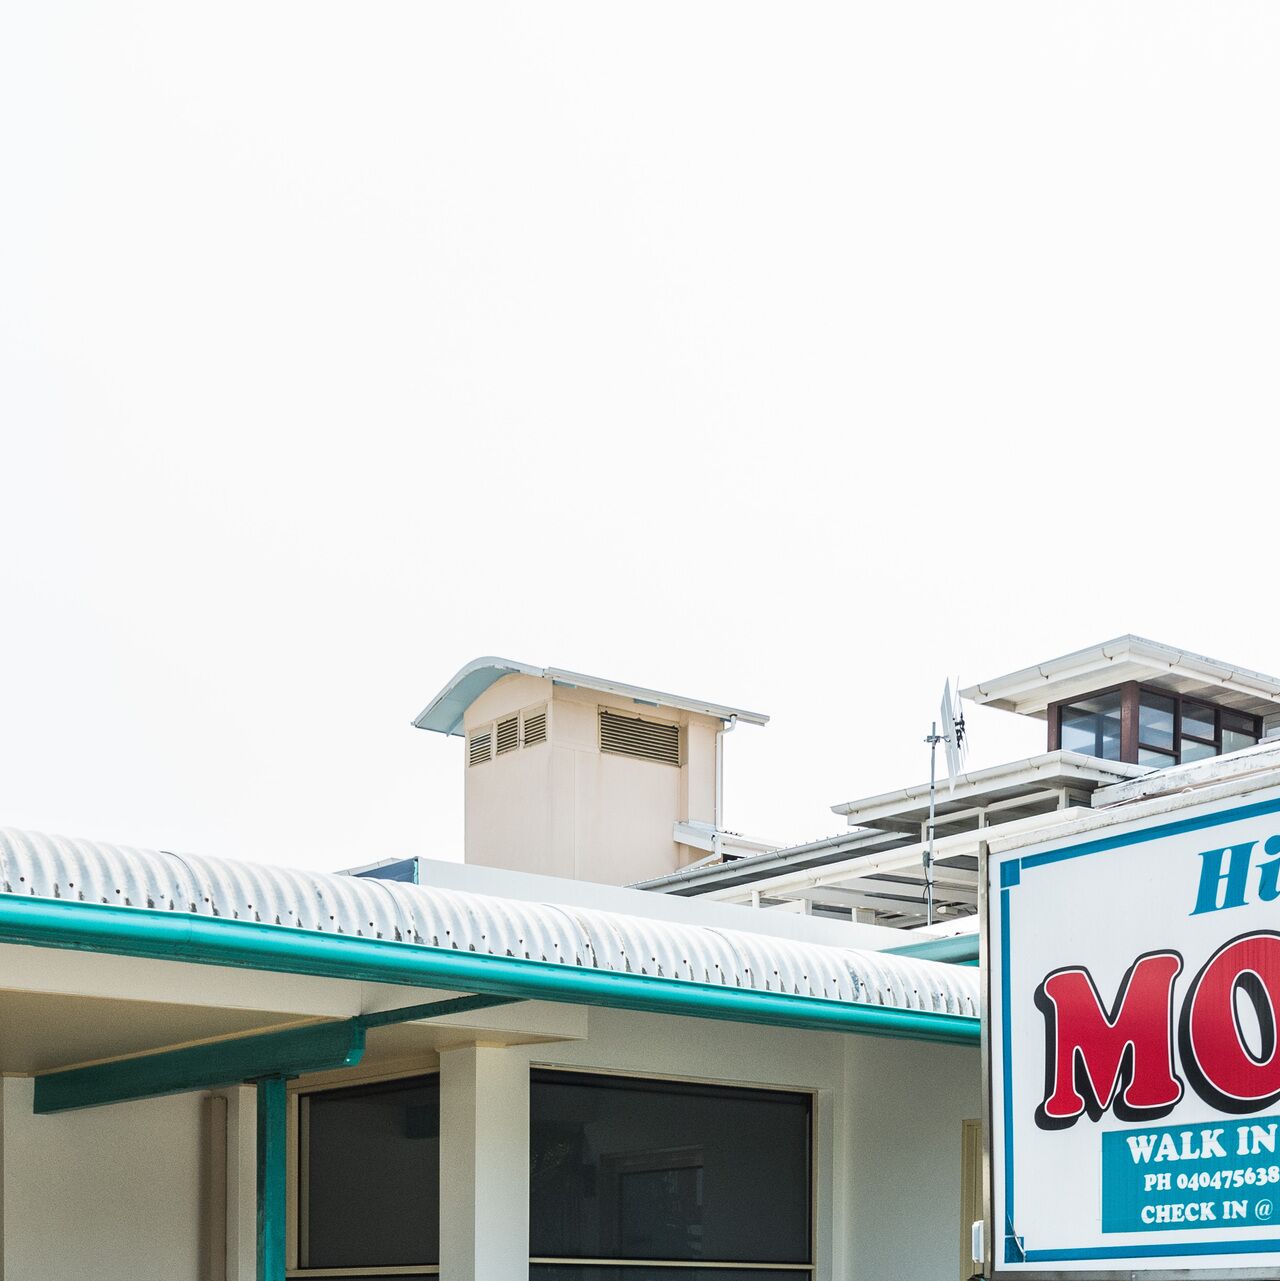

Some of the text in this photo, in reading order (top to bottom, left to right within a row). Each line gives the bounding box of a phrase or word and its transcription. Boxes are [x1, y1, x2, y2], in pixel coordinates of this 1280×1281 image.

[1126, 1128, 1227, 1165] WALK
[1236, 1123, 1278, 1155] IN
[1143, 1173, 1172, 1192] PH
[1140, 1201, 1216, 1225] CHECK
[1222, 1200, 1249, 1220] IN
[1254, 1198, 1273, 1221] @
